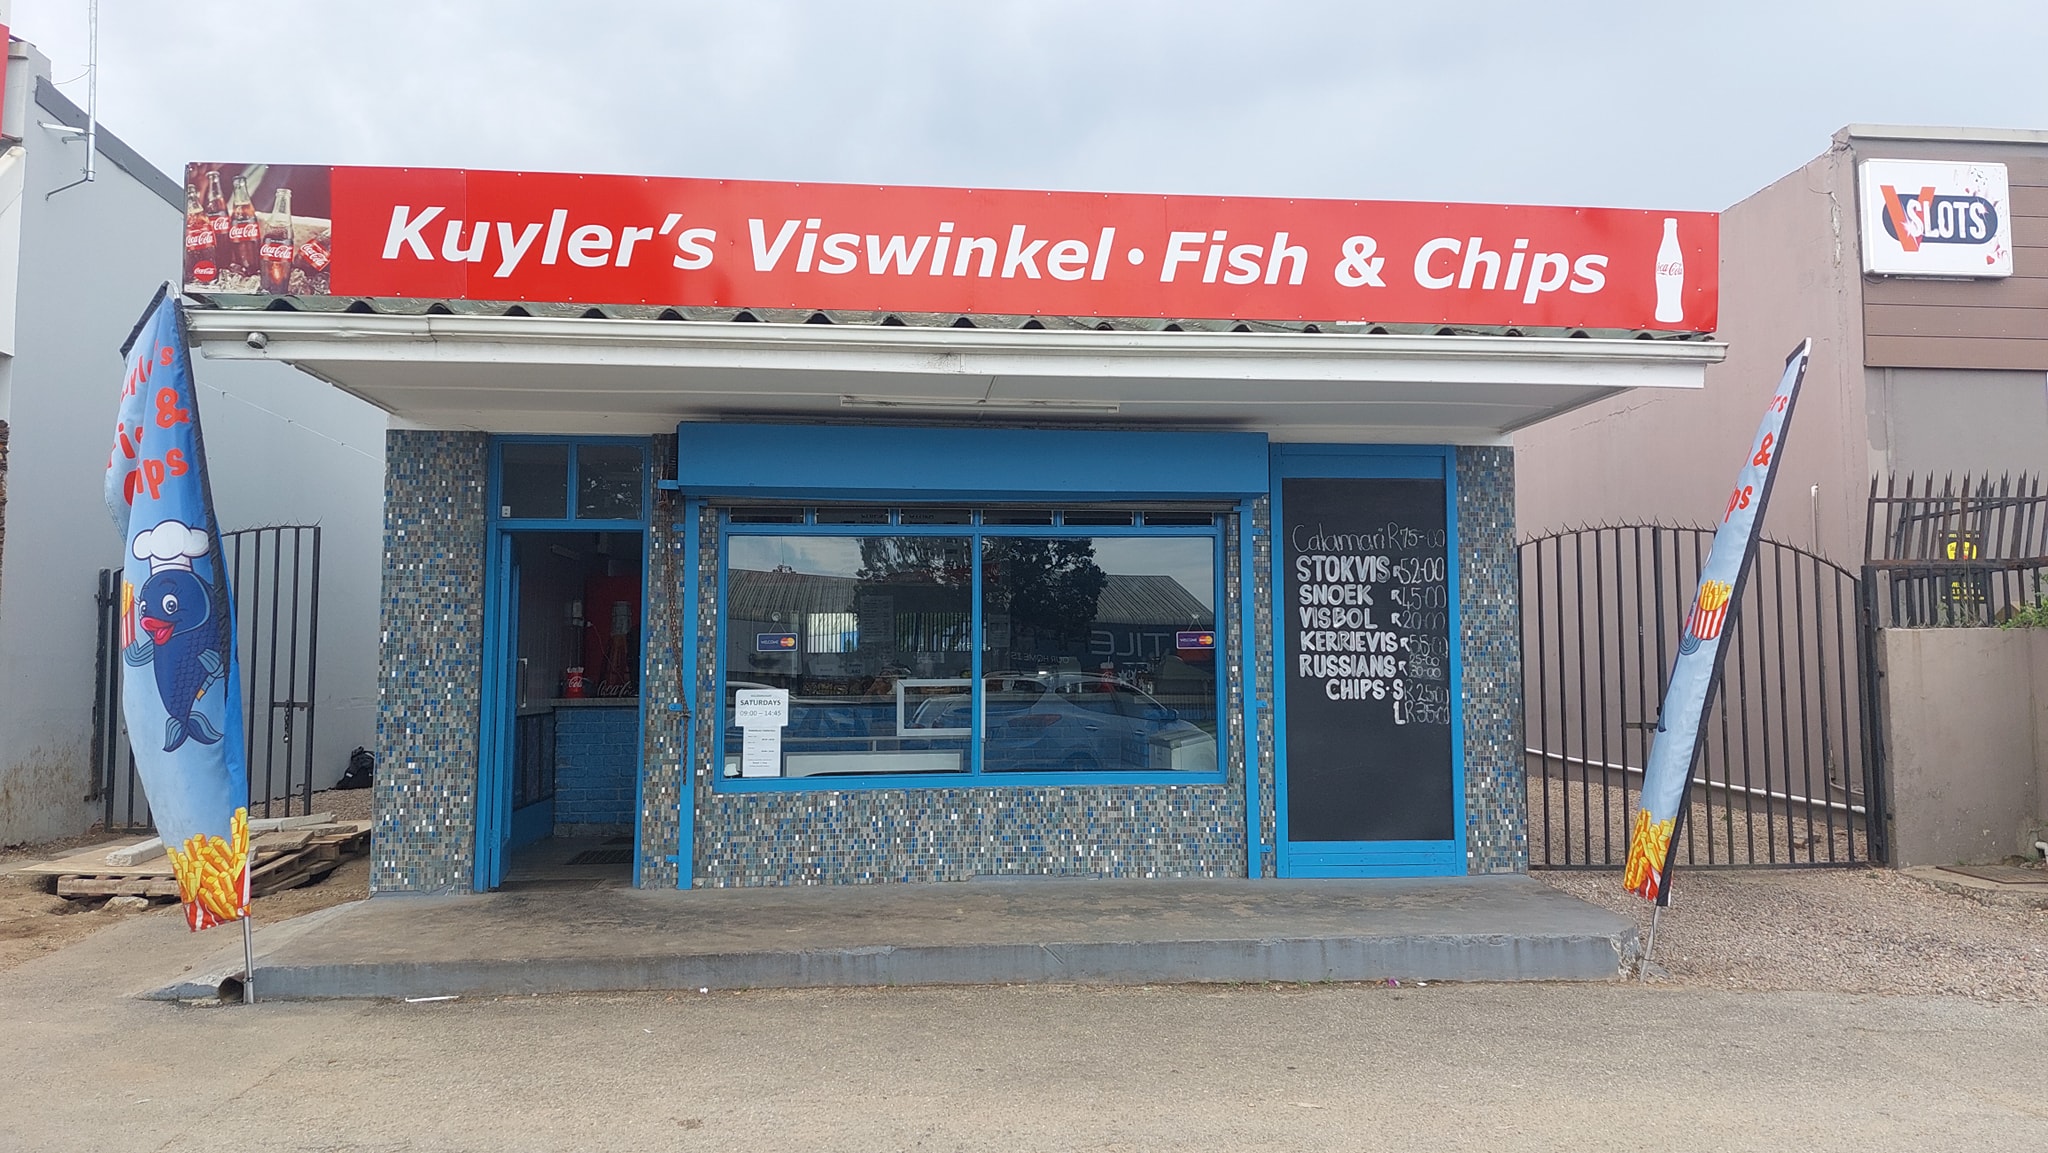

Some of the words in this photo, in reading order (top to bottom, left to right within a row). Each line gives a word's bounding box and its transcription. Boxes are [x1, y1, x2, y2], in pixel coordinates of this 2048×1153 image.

[1906, 199, 1986, 240] SLOTS
[749, 219, 1115, 281] Viswinkel
[1160, 232, 1307, 285] Fish
[1335, 236, 1386, 288] &
[1414, 237, 1608, 304] Chips
[1292, 523, 1384, 552] Calamari
[1296, 555, 1390, 583] STOKVIS
[1299, 584, 1373, 605] SNOEK
[1300, 607, 1378, 629] VISBOL
[1300, 631, 1398, 652] KERRIEVIS
[1299, 654, 1397, 678] RUSSIANS
